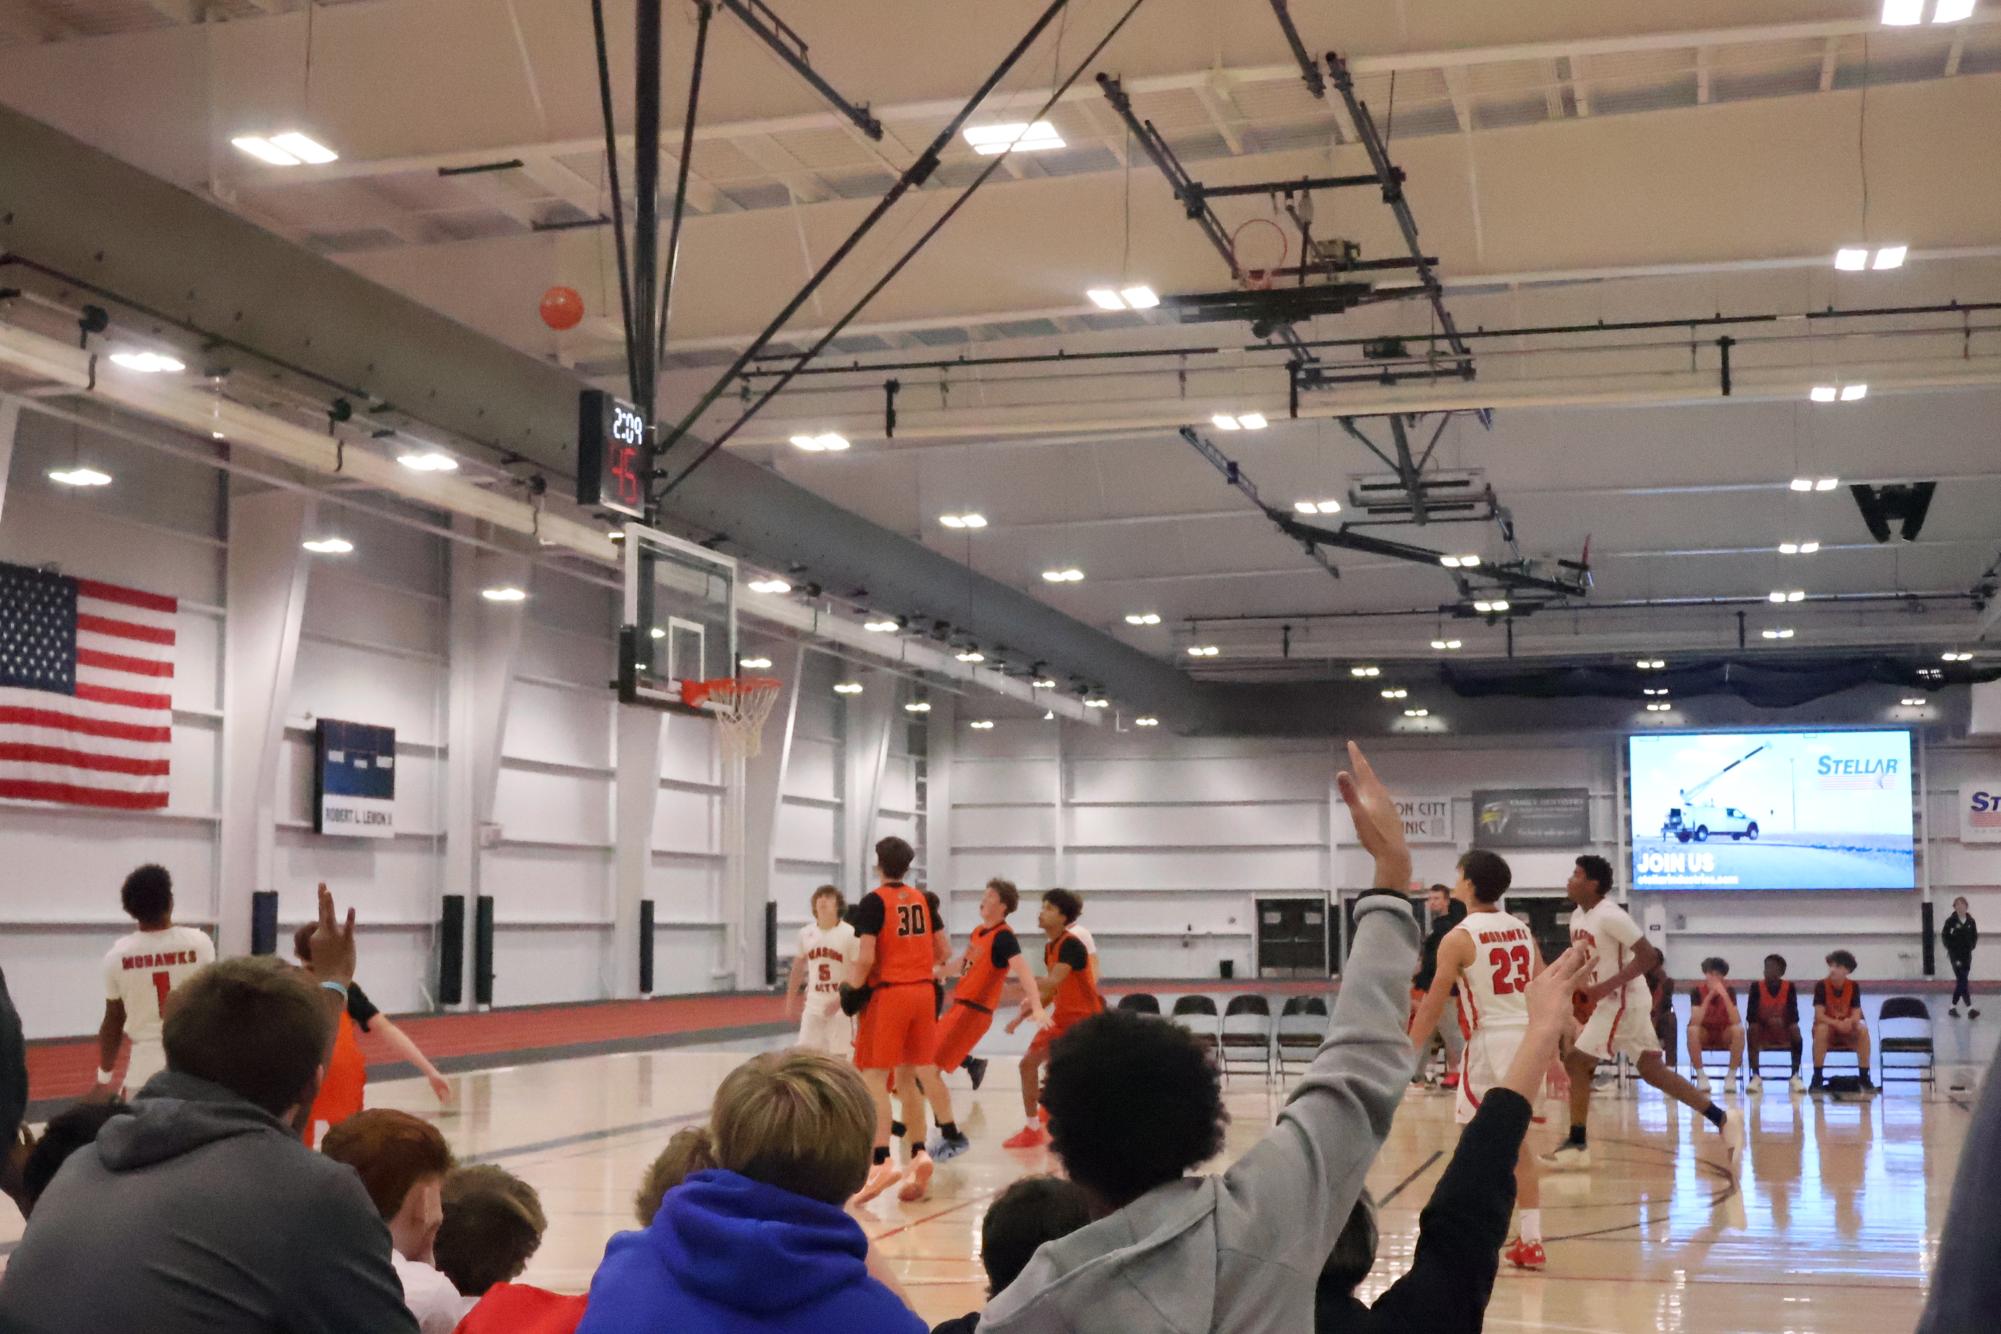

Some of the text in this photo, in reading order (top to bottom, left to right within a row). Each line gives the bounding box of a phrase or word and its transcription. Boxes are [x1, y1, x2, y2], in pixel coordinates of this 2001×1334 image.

[613, 407, 642, 445] 2:09
[1817, 755, 1898, 775] STELLAR
[1419, 802, 1446, 816] CITY
[1637, 853, 1714, 873] JOIN US
[897, 904, 926, 936] 30
[122, 950, 197, 970] MOHAWKS
[1490, 945, 1530, 995] 23
[818, 964, 831, 981] 5
